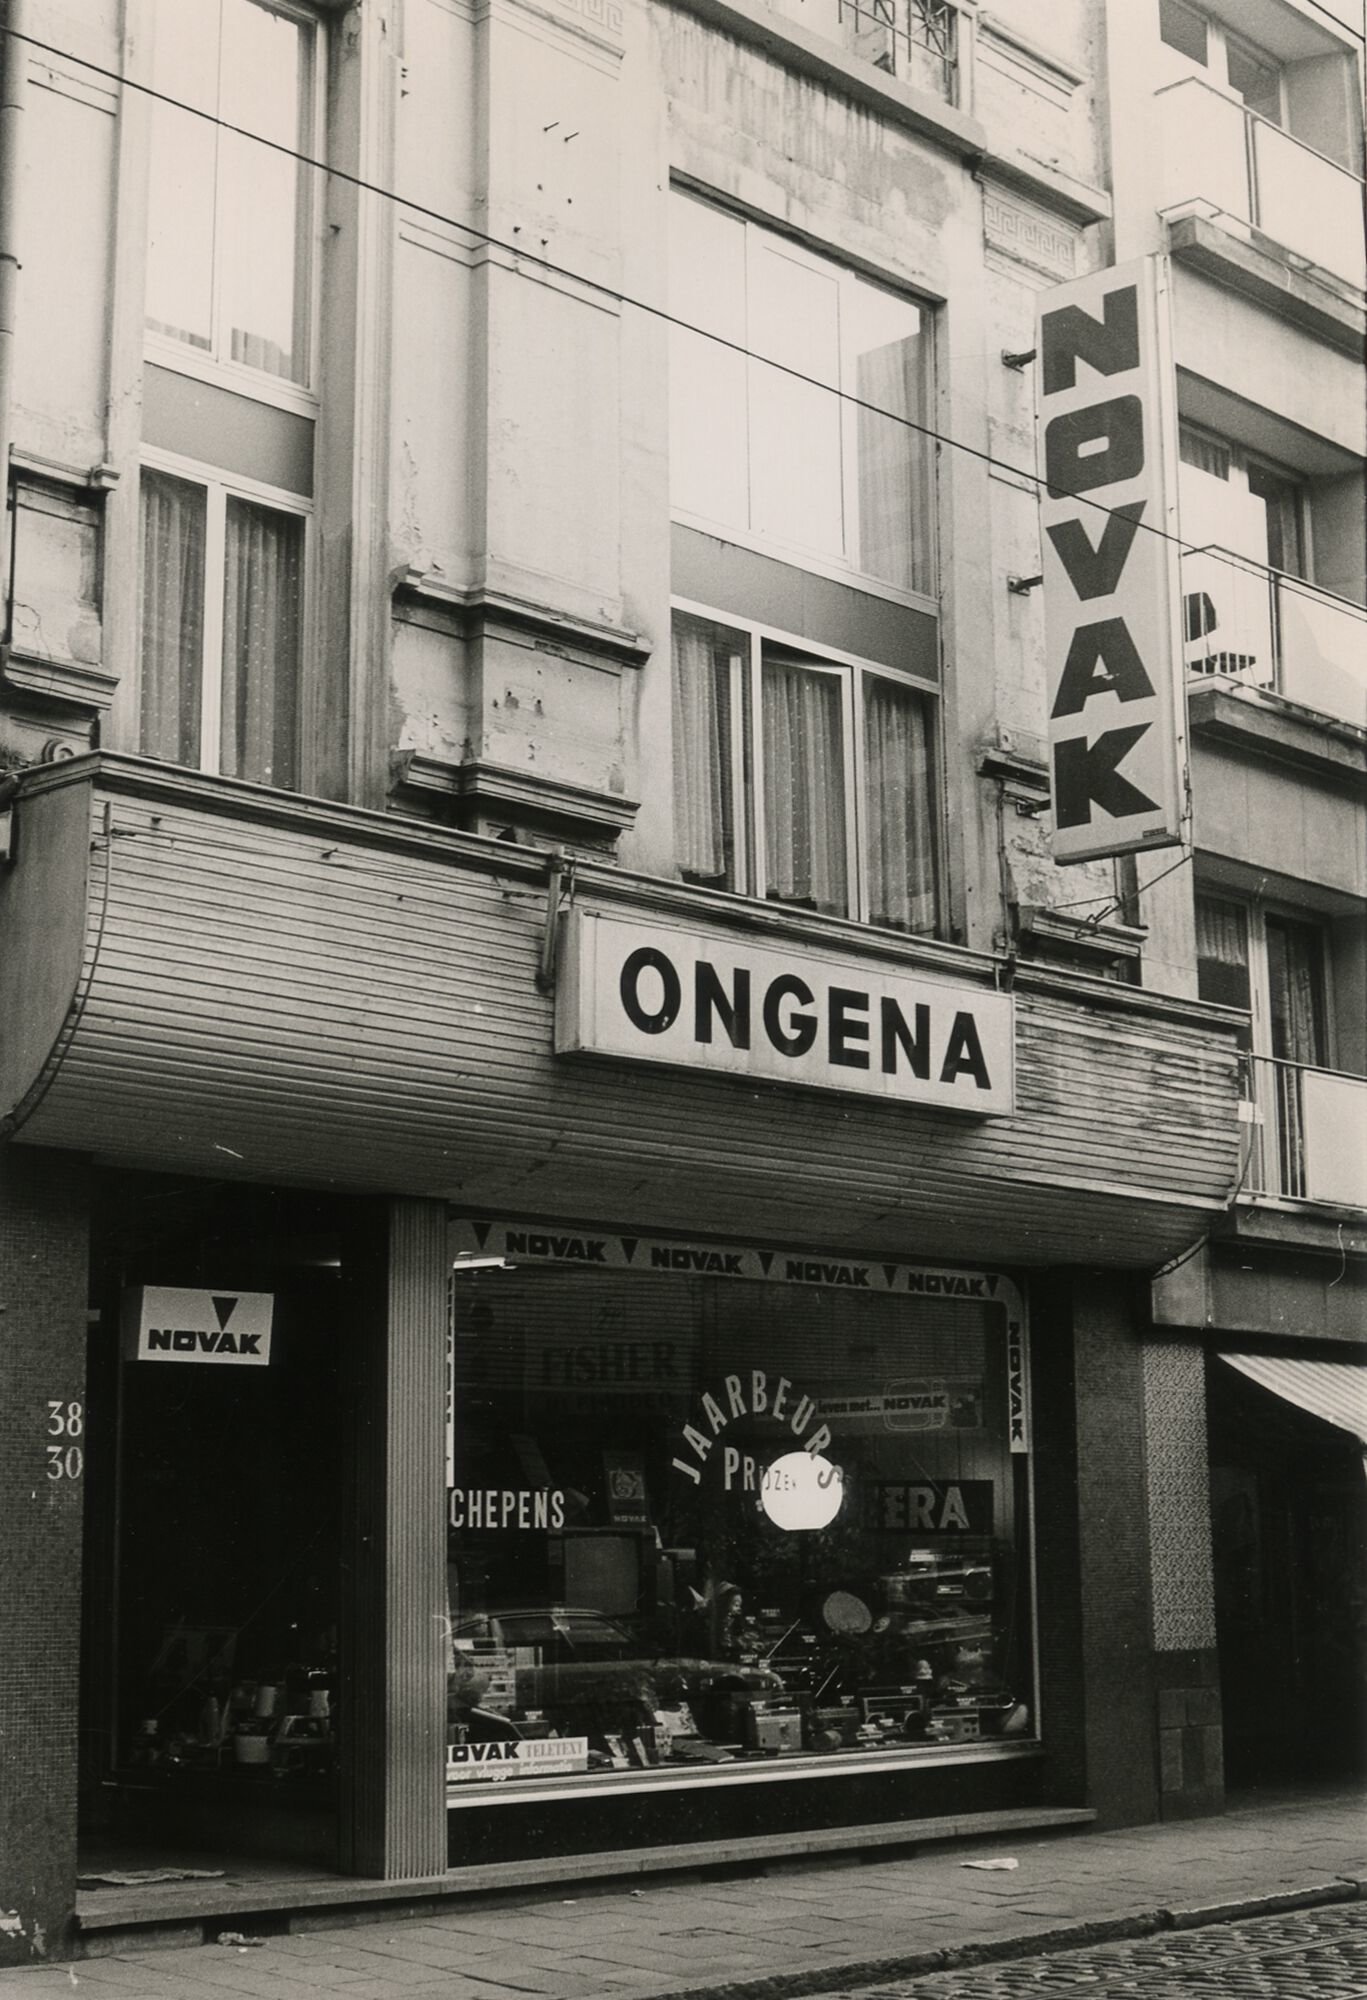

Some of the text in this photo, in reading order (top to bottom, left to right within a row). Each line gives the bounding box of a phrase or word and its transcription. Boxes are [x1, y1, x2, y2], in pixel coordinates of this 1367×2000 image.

[1042, 283, 1162, 830] NOVAK
[620, 946, 992, 1090] ONGENA
[505, 1231, 985, 1297] NOVAK NOVAK NOVAK NOVAK
[148, 1329, 262, 1355] NOVAK
[542, 1342, 678, 1384] FISHER
[883, 1395, 946, 1410] NOVAK
[1009, 1321, 1023, 1442] NOVAK
[47, 1401, 83, 1437] 38
[672, 1369, 844, 1490] JAARBEURS
[46, 1445, 84, 1480] 30
[724, 1446, 797, 1491] PRIJZE
[450, 1488, 565, 1529] CHEPENS
[878, 1486, 970, 1529] ERA
[447, 1741, 583, 1763] OVAK TELETEXT
